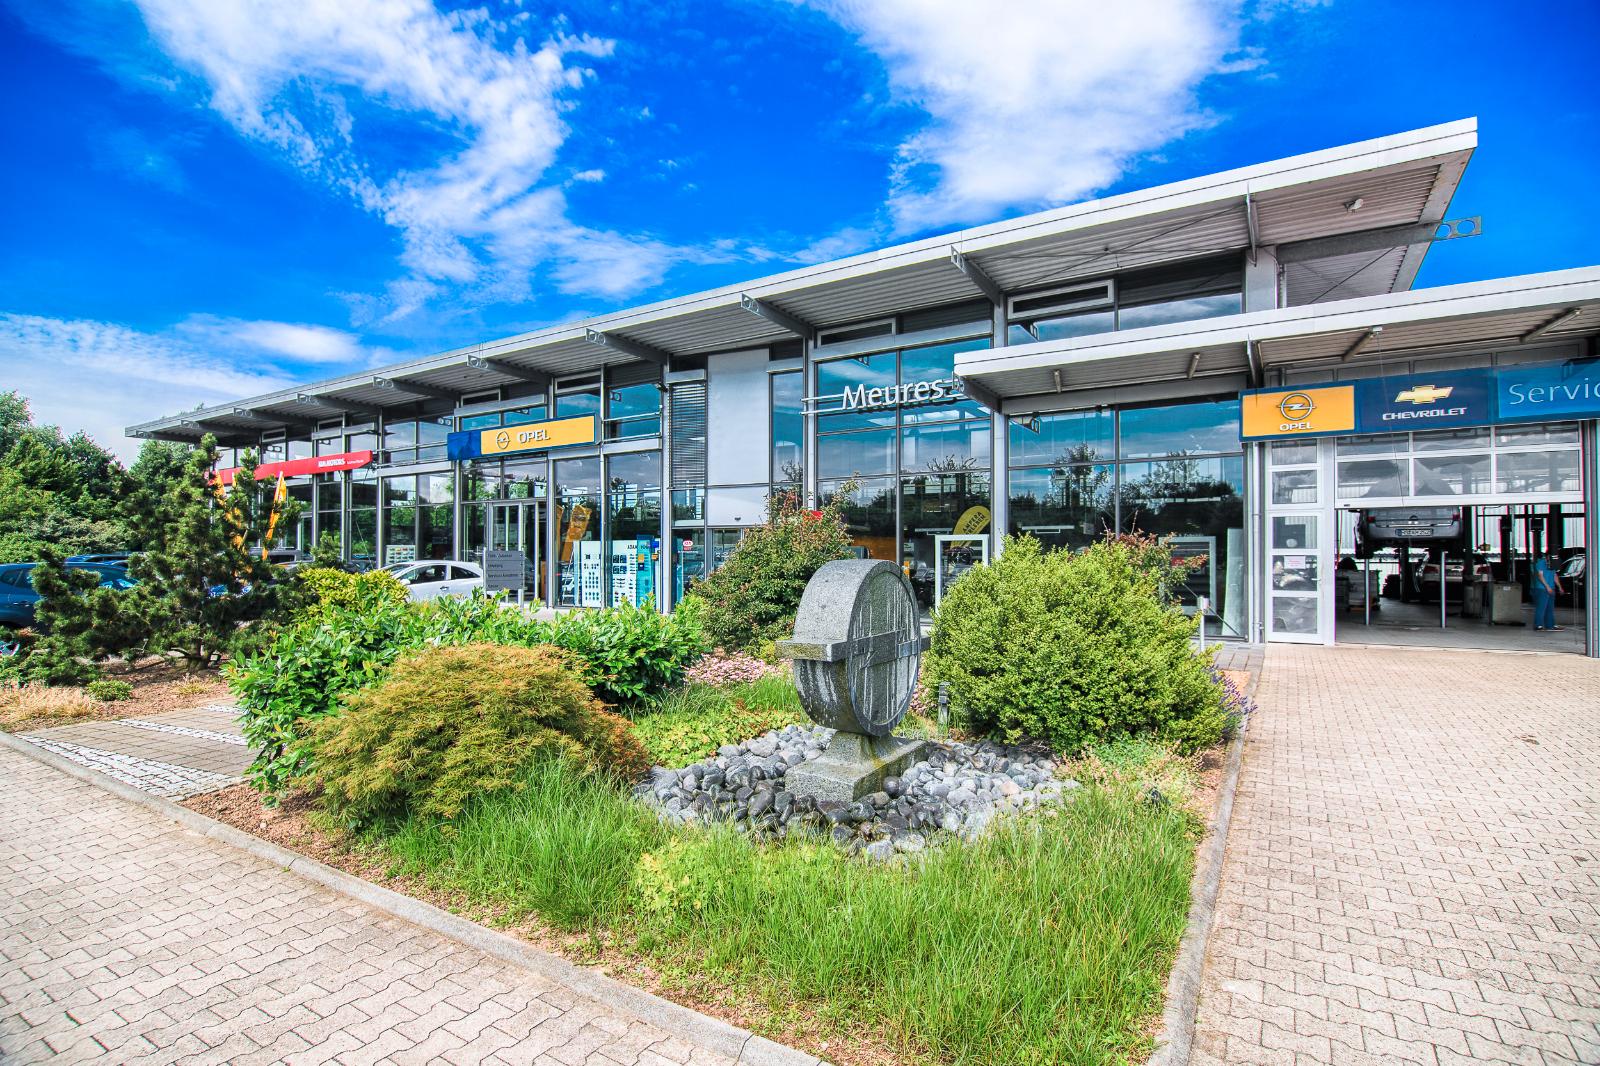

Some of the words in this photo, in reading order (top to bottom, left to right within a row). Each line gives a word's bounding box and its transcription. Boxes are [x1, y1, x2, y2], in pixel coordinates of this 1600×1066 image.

[842, 379, 944, 409] Meures
[1382, 407, 1467, 421] CHEVROLET
[1279, 421, 1313, 432] OPEL
[517, 430, 550, 444] OPEL
